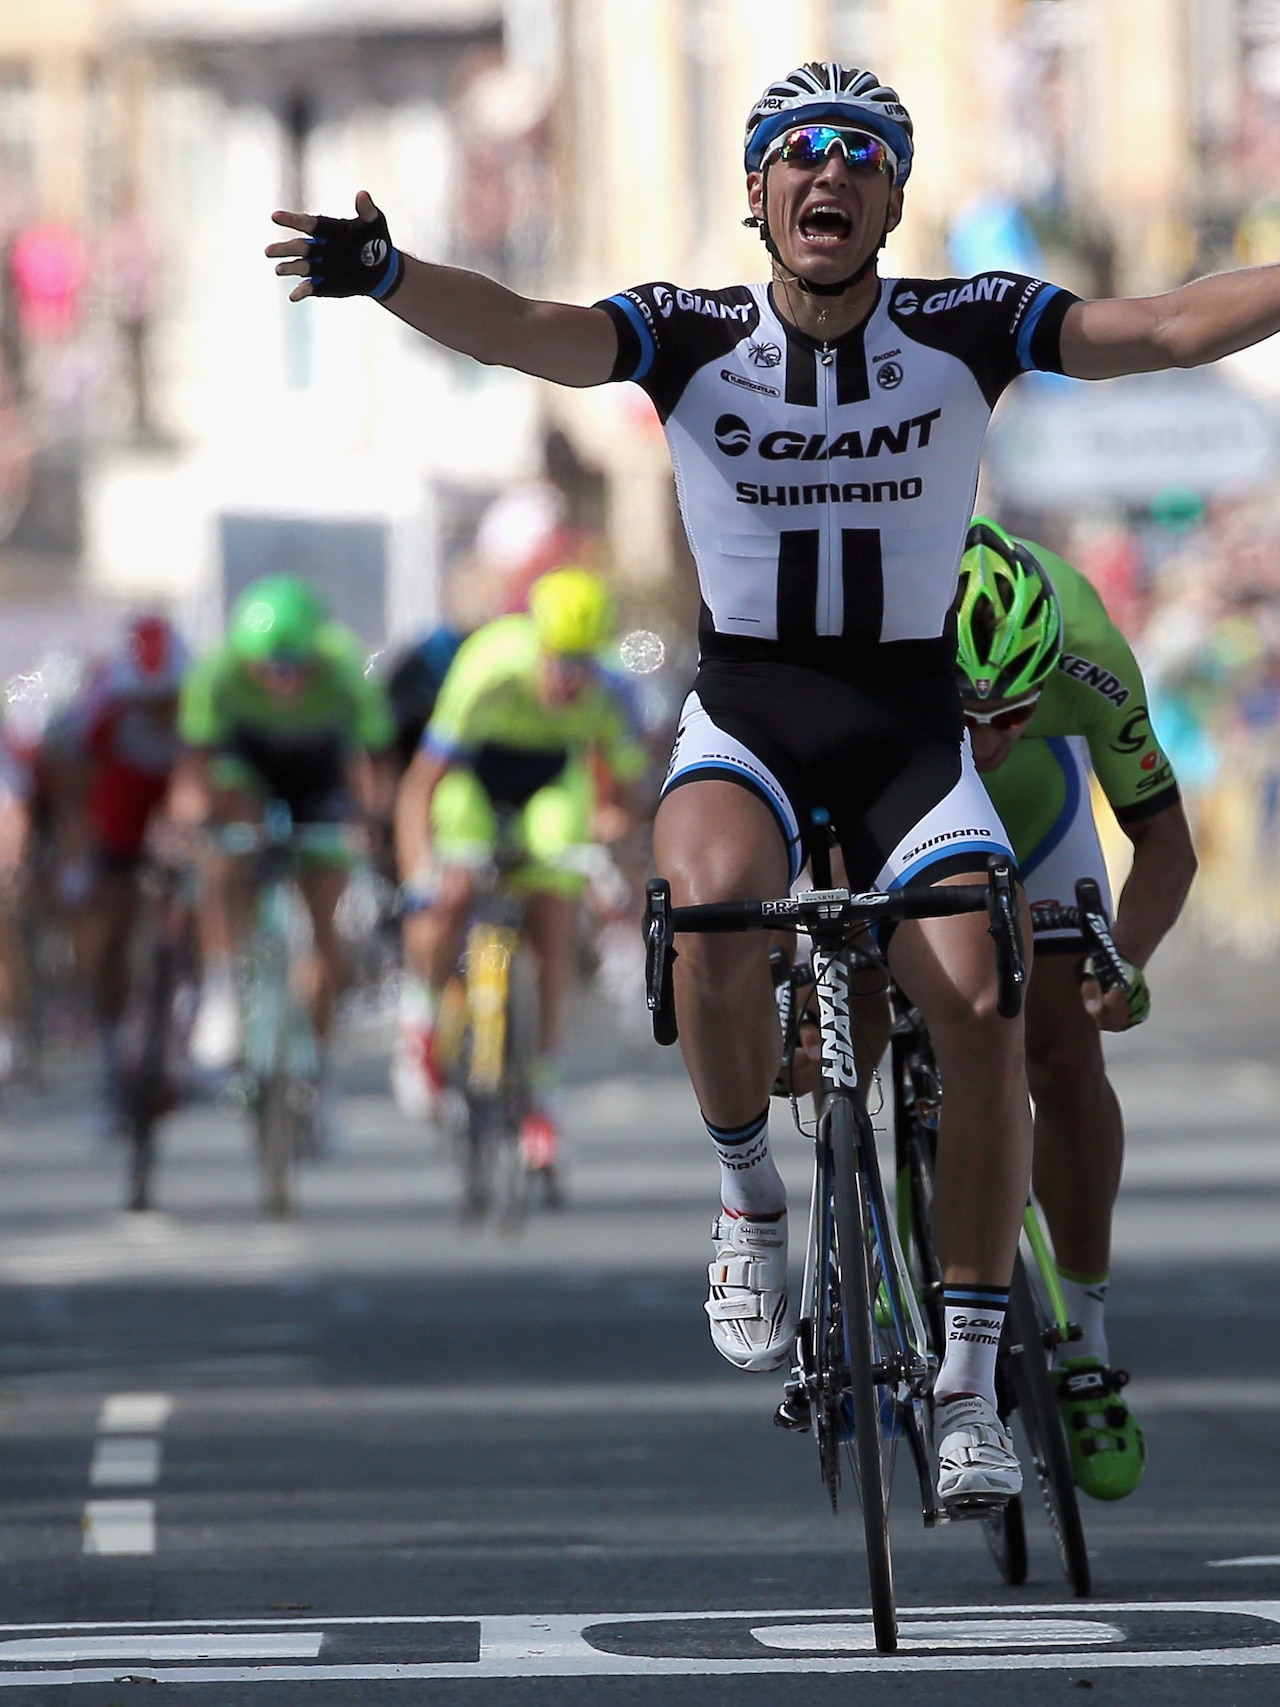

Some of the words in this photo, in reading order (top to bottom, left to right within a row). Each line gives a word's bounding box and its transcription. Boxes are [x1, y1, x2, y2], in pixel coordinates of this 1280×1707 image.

[676, 289, 754, 324] GIANT
[922, 277, 1017, 314] GIANT
[758, 407, 942, 461] GIANT
[735, 476, 923, 506] SHIMANO
[1056, 652, 1131, 708] KENDA
[902, 828, 992, 864] SHIMANO
[813, 951, 841, 1088] GIANT
[826, 959, 858, 1088] GIANT
[740, 1227, 778, 1236] SHIMANO
[948, 1331, 1000, 1346] SHIMA
[968, 1318, 1001, 1331] GIA
